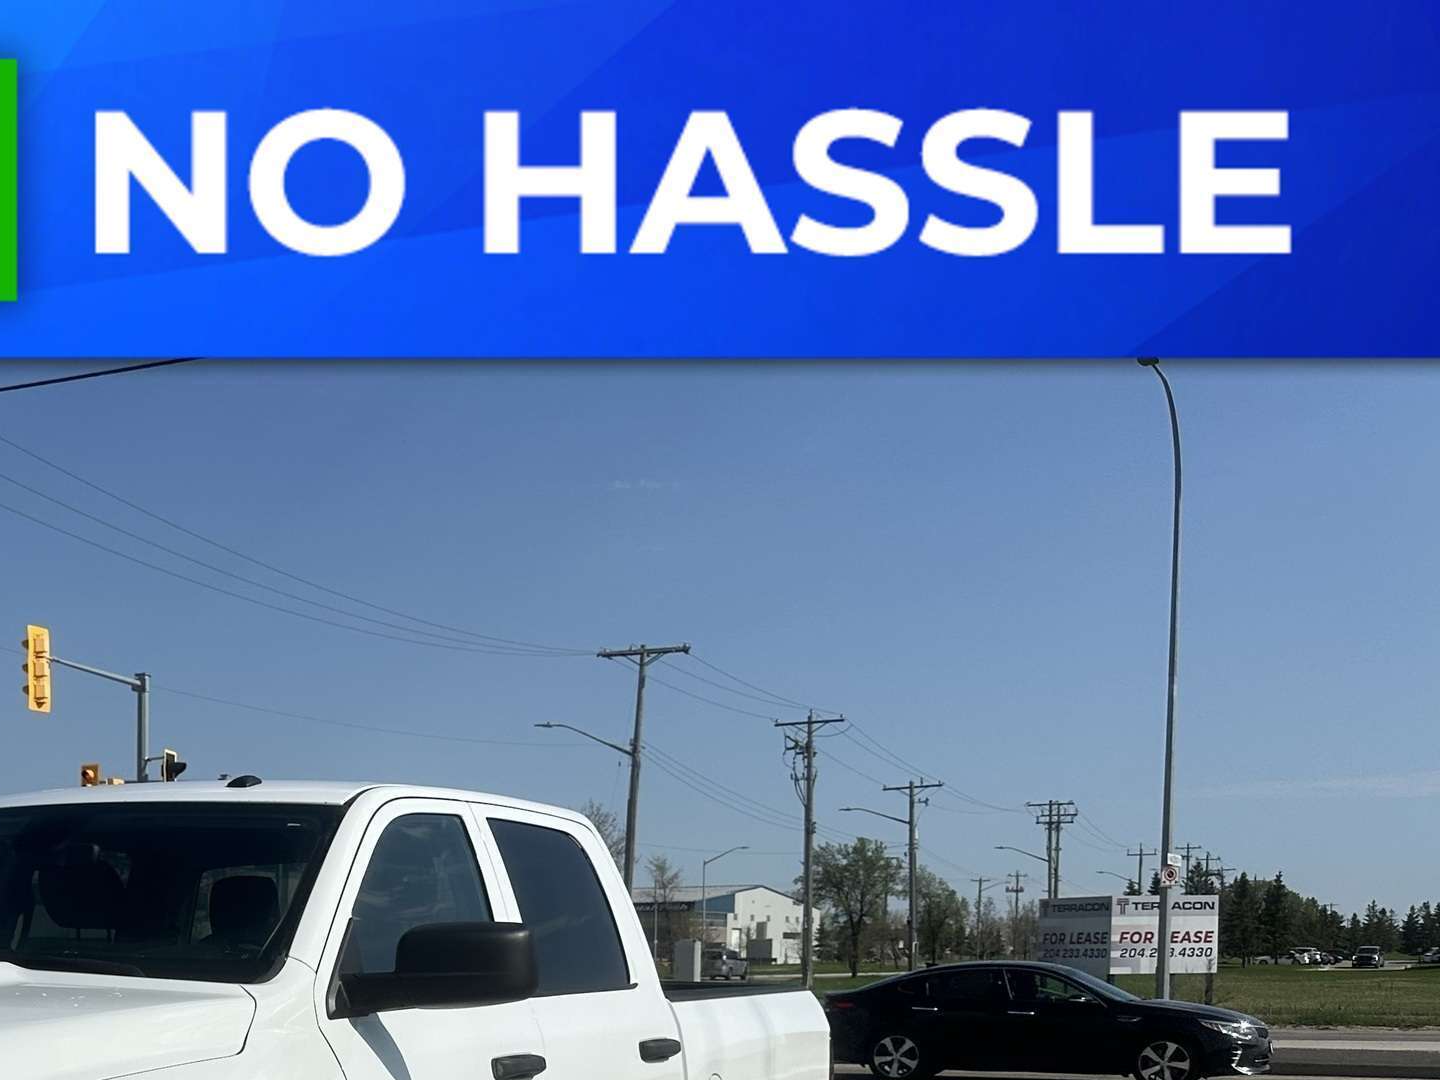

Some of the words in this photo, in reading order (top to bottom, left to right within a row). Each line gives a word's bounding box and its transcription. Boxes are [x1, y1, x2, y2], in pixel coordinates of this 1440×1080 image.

[1052, 902, 1110, 913] TERRACON
[1133, 901, 1216, 912] TERACON
[1042, 932, 1066, 945] FOR
[1069, 931, 1109, 945] LEASE
[1118, 931, 1155, 945] FOR
[1169, 930, 1215, 944] EASE
